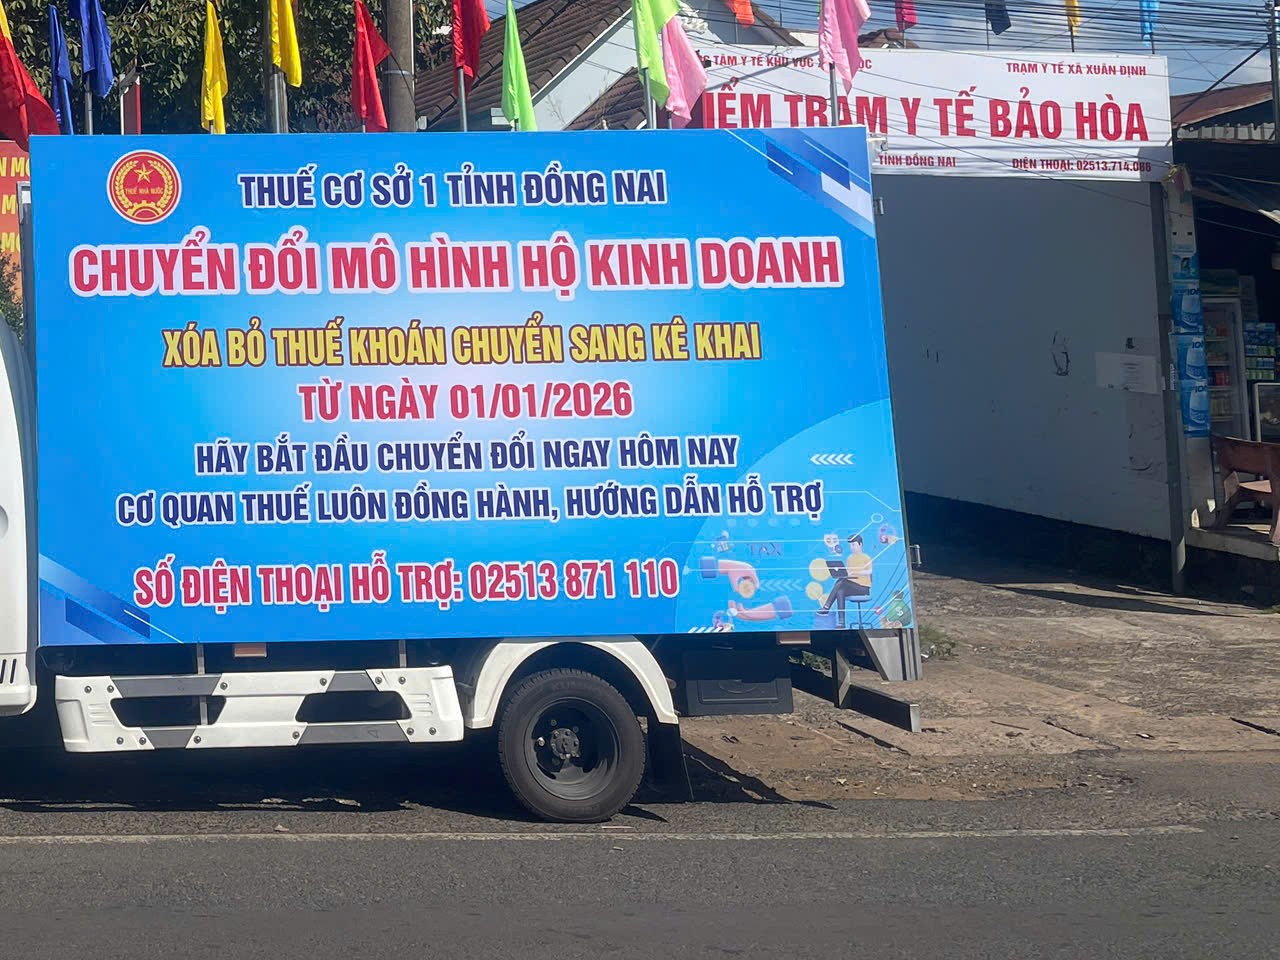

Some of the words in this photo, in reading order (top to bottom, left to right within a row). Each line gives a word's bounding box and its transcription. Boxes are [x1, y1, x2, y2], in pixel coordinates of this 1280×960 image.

[714, 54, 737, 66] TÂM
[741, 56, 747, 66] Y
[752, 54, 763, 66] TẾ
[1006, 62, 1037, 75] TRẠM
[1041, 63, 1048, 73] Y
[1051, 61, 1065, 74] TẾ
[1068, 62, 1082, 74] XÃ
[1086, 63, 1117, 75] XUÂN
[1120, 65, 1147, 77] ĐỊNH
[900, 97, 921, 136] Y
[933, 86, 977, 137] TẾ
[989, 86, 1062, 140] BẢO
[1075, 93, 1149, 141] HÒA
[878, 153, 903, 166] TỈNH
[905, 153, 934, 167] ĐỒNG
[938, 156, 956, 167] NAI
[1012, 157, 1037, 170] ĐIỆN
[1040, 158, 1075, 173] THOẠI:
[241, 165, 318, 207] THUẾ
[324, 171, 363, 207] CƠ
[372, 163, 412, 206] SỞ
[421, 174, 436, 206] 1
[446, 163, 515, 205] TỈNH
[523, 162, 605, 204] ĐỒNG
[614, 171, 666, 203] NAI
[72, 230, 236, 292] CHUYỂN
[248, 229, 317, 290] ĐỔI
[331, 237, 396, 289] MÔ
[411, 234, 509, 289] HÌNH
[522, 236, 576, 296] HỘ
[589, 243, 688, 286] KINH
[701, 241, 841, 285] DOANH
[162, 321, 221, 367] XÓA
[227, 316, 265, 366] BỎ
[273, 317, 344, 365] THUẾ
[350, 320, 446, 365] KHOÁN
[452, 311, 563, 364] CHUYỂN
[570, 324, 646, 362] SANG
[652, 316, 690, 361] KÊ
[694, 321, 762, 360] KHAI
[298, 378, 343, 421] TỪ
[351, 378, 439, 420] NGÀY
[450, 381, 633, 420] 01/01/2026
[196, 439, 247, 473] HÃY
[257, 434, 307, 473] BẮT
[314, 434, 369, 472] ĐẦU
[377, 431, 483, 471] CHUYỂN
[490, 430, 536, 469] ĐỔI
[543, 439, 611, 469] NGAY
[619, 434, 680, 468] HÔM
[687, 436, 738, 466] NAY
[117, 492, 155, 524] CƠ
[163, 495, 234, 528] QUAN
[241, 483, 311, 521] THUẾ
[318, 486, 387, 520] LUÔN
[394, 481, 469, 520] ĐỒNG
[476, 485, 558, 521] HÀNH,
[566, 481, 657, 516] HƯỚNG
[665, 474, 722, 514] DẪN
[729, 474, 764, 514] HỖ
[771, 481, 823, 519] TRỢ
[134, 554, 175, 607] SỐ
[181, 561, 251, 613] ĐIỆN
[257, 566, 341, 612] THOẠI
[351, 551, 391, 602] HỖ
[397, 560, 463, 610] TRỢ:
[469, 562, 557, 600] 02513
[565, 560, 615, 598] 871
[626, 559, 679, 597] 110
